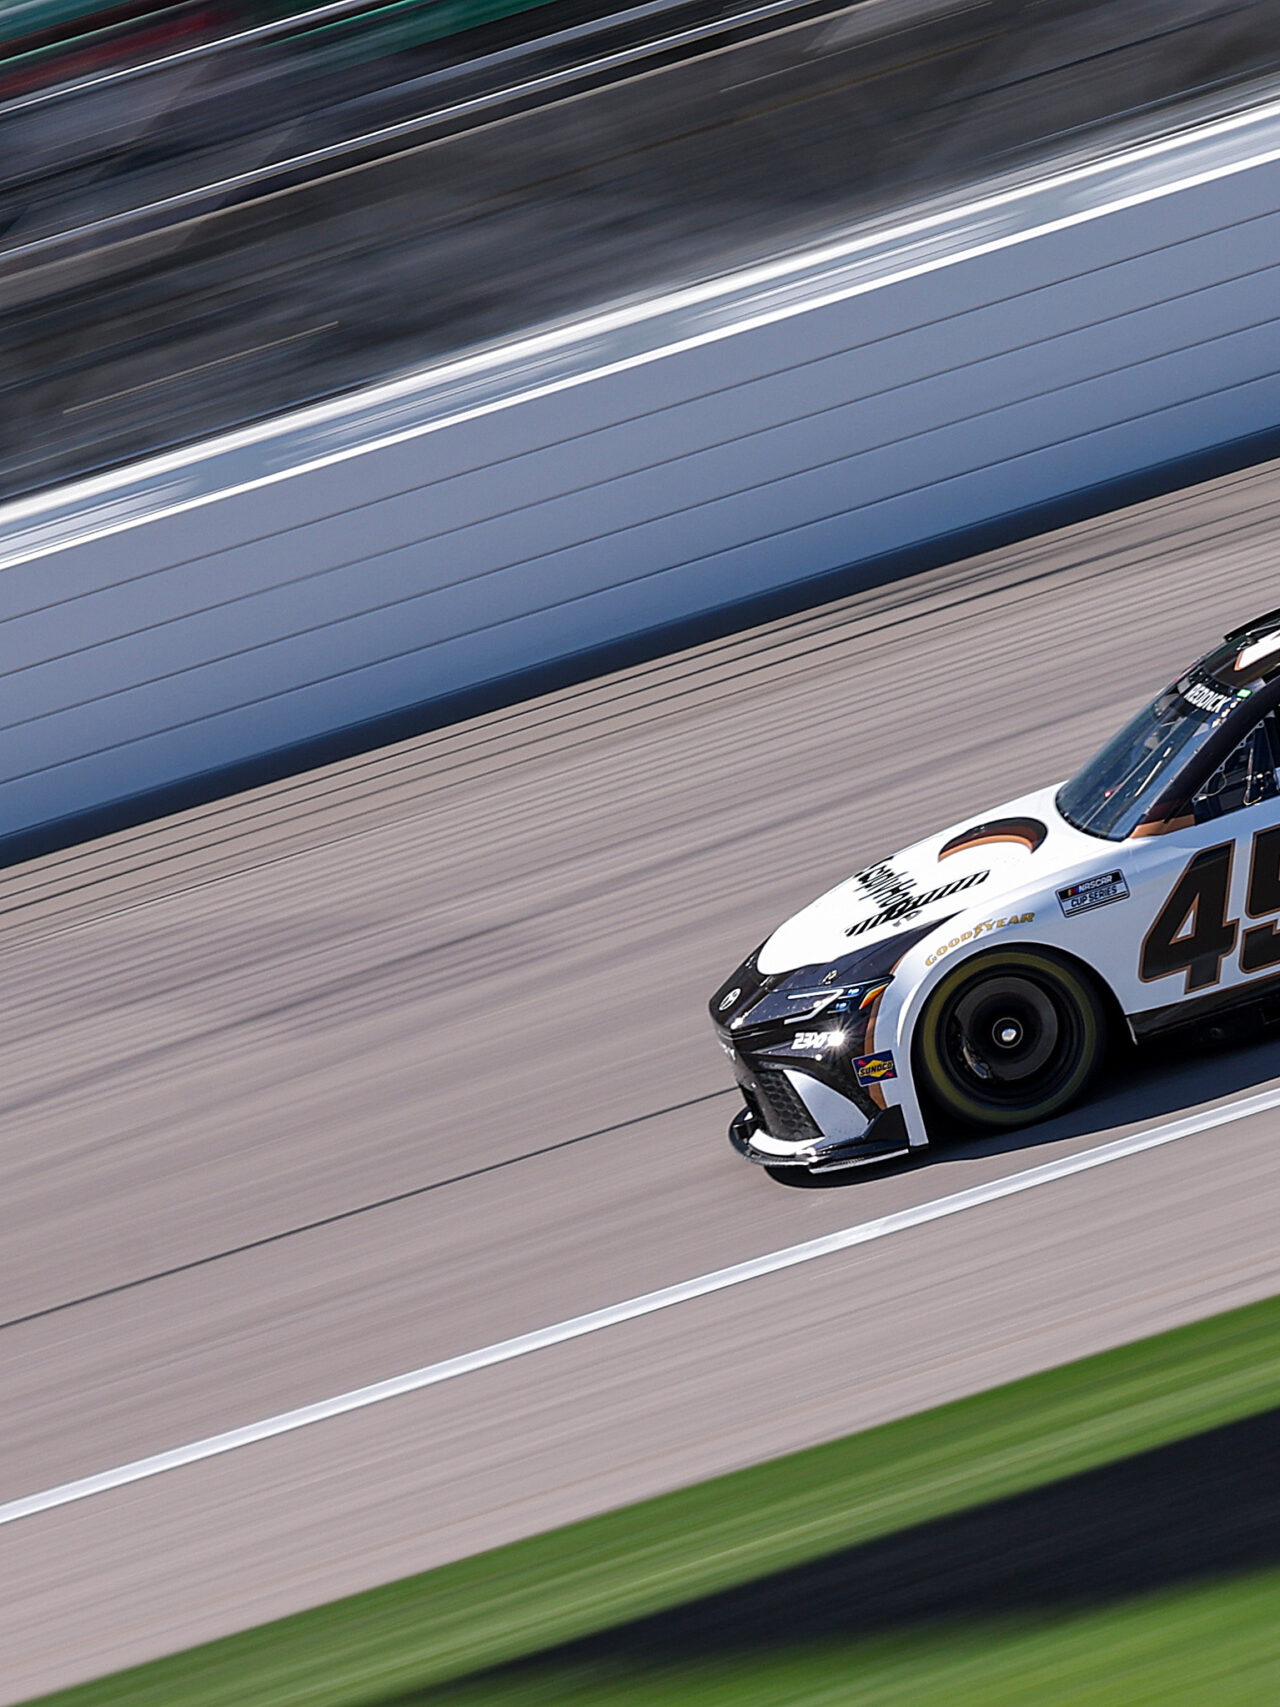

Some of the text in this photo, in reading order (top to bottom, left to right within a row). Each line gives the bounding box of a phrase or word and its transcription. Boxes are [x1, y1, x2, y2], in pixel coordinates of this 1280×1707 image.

[1184, 683, 1231, 713] REDDICK
[1078, 875, 1113, 893] NASCAR
[1071, 885, 1118, 907] CUP SERIES
[925, 912, 1036, 966] GOODYEAR
[859, 1060, 894, 1077] SUNOCO
